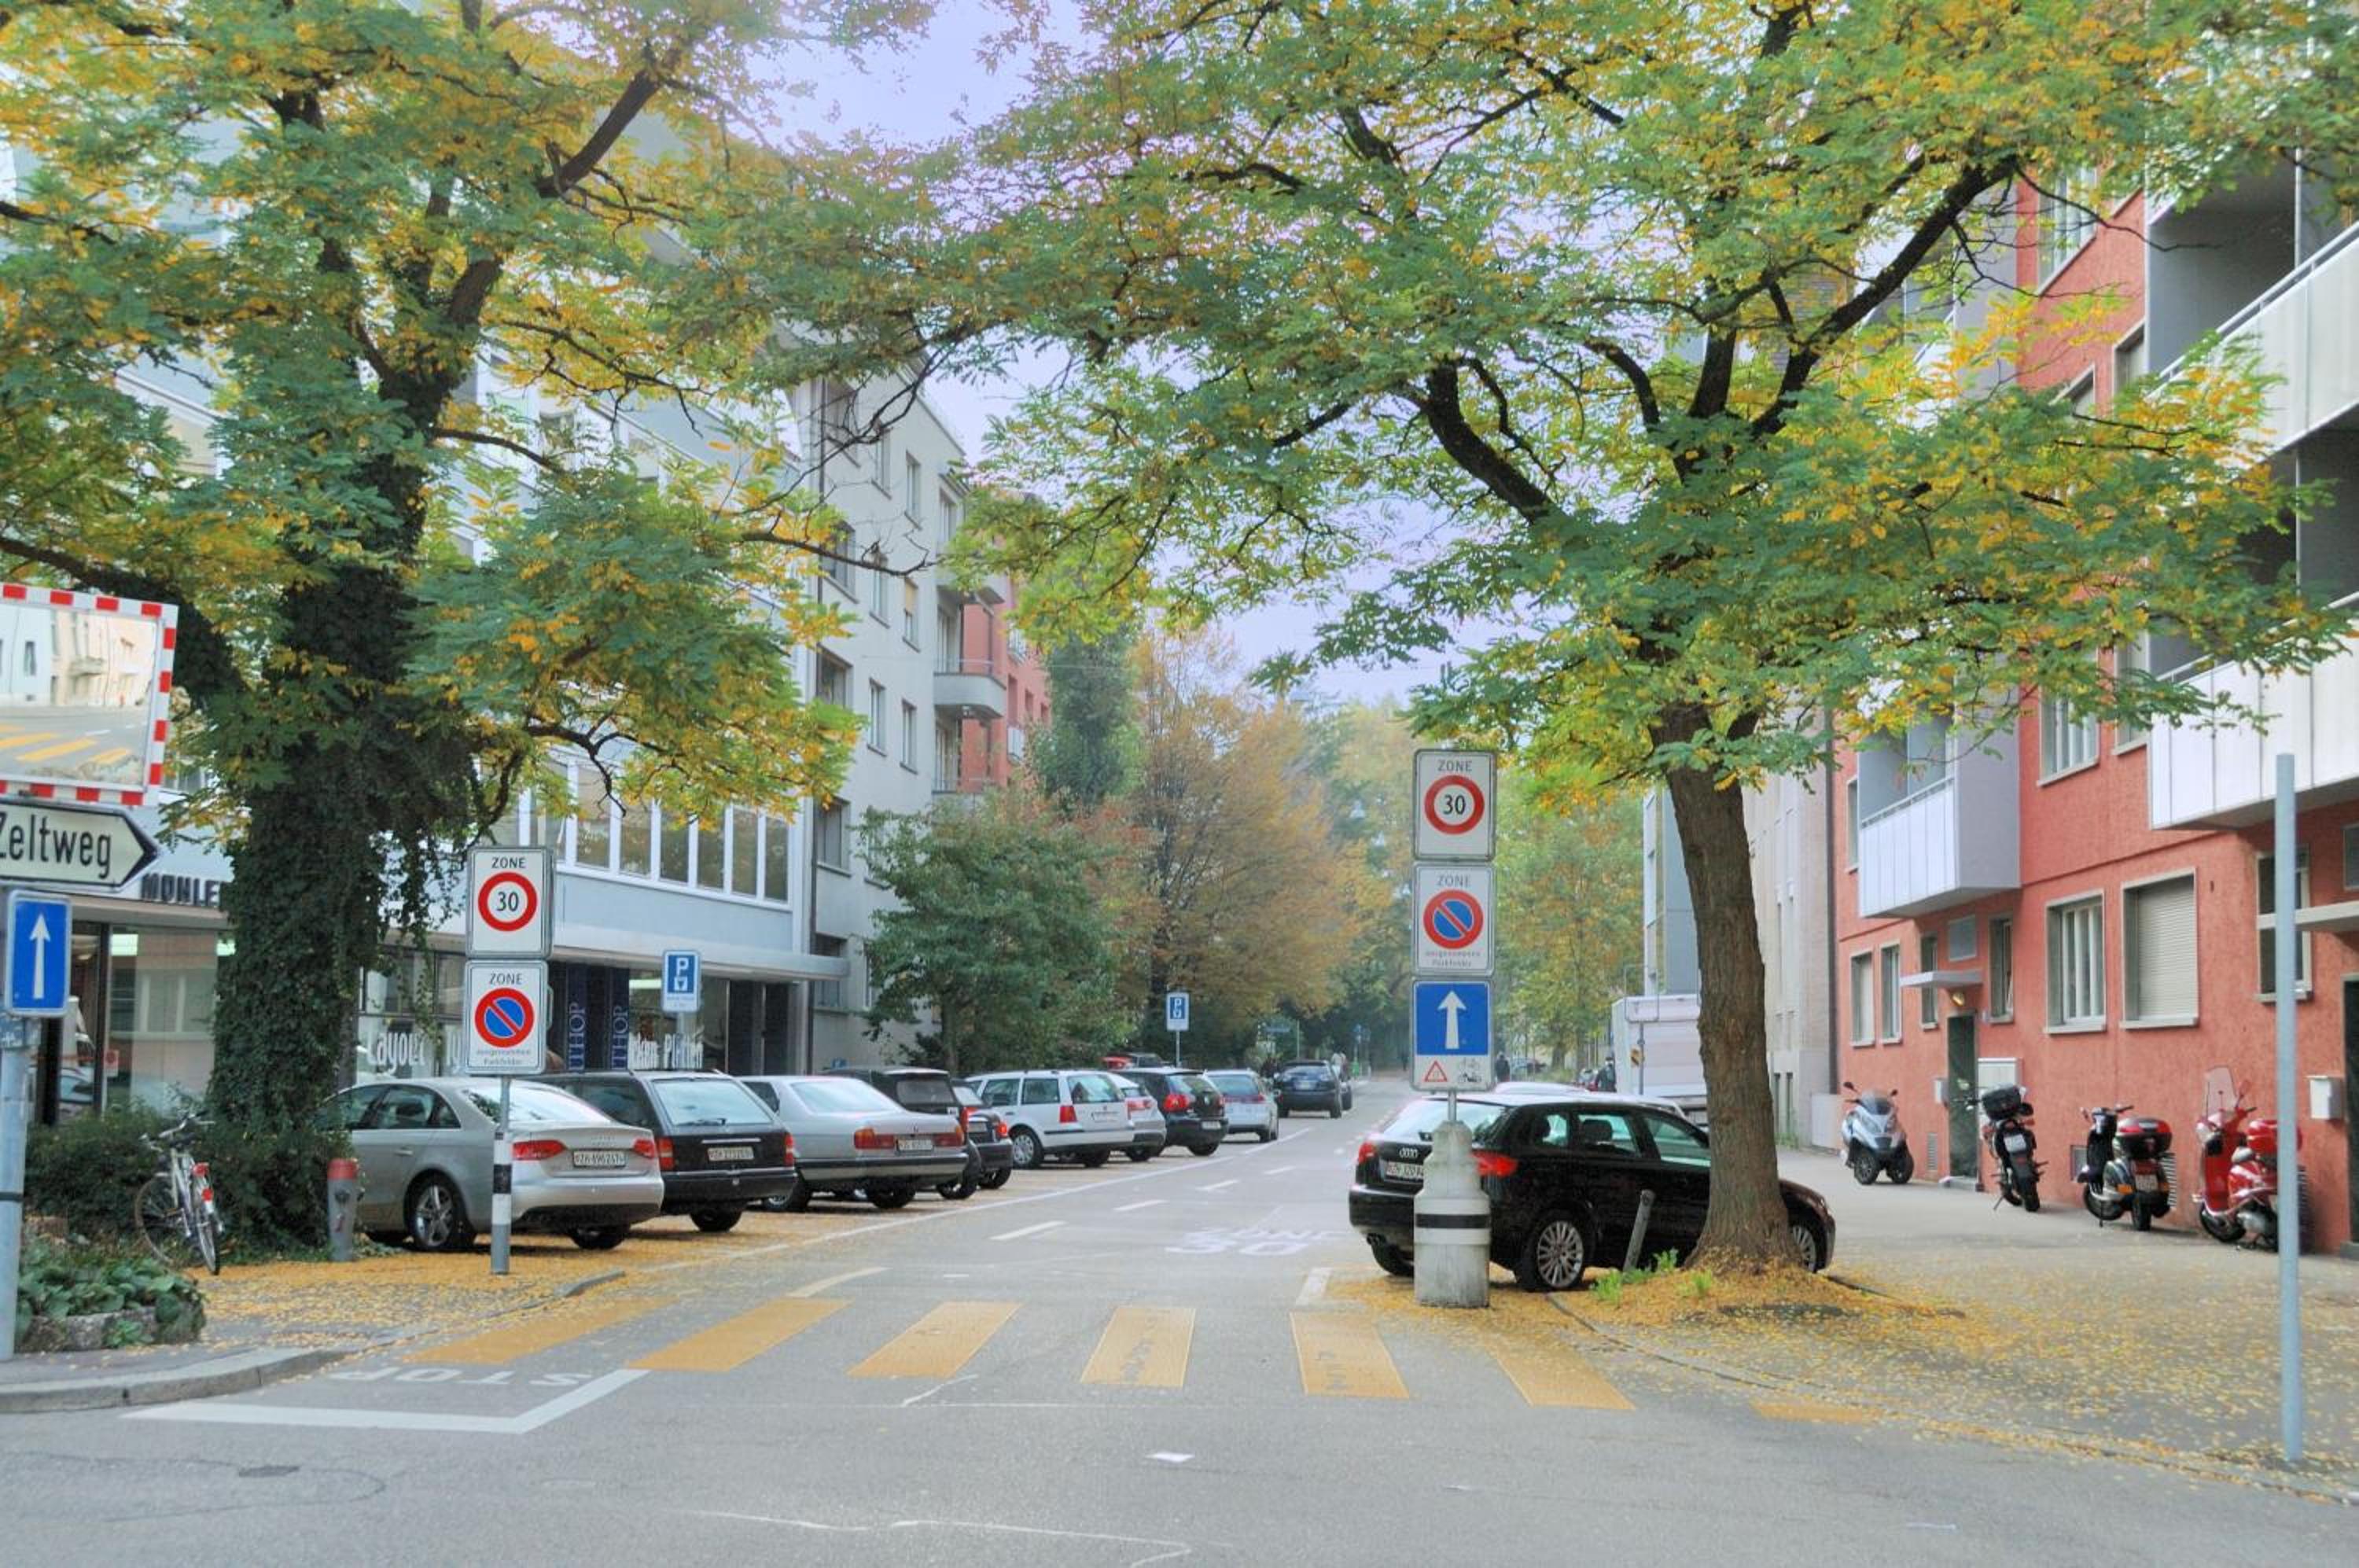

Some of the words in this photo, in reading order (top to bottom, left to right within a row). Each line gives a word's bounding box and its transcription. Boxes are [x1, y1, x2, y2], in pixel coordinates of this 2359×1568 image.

[1437, 759, 1473, 772] ZONE
[1443, 793, 1466, 815] 30
[491, 856, 526, 869] ZONE
[1437, 874, 1471, 886] ZONE
[496, 891, 520, 912] 30
[489, 973, 524, 985] ZONE
